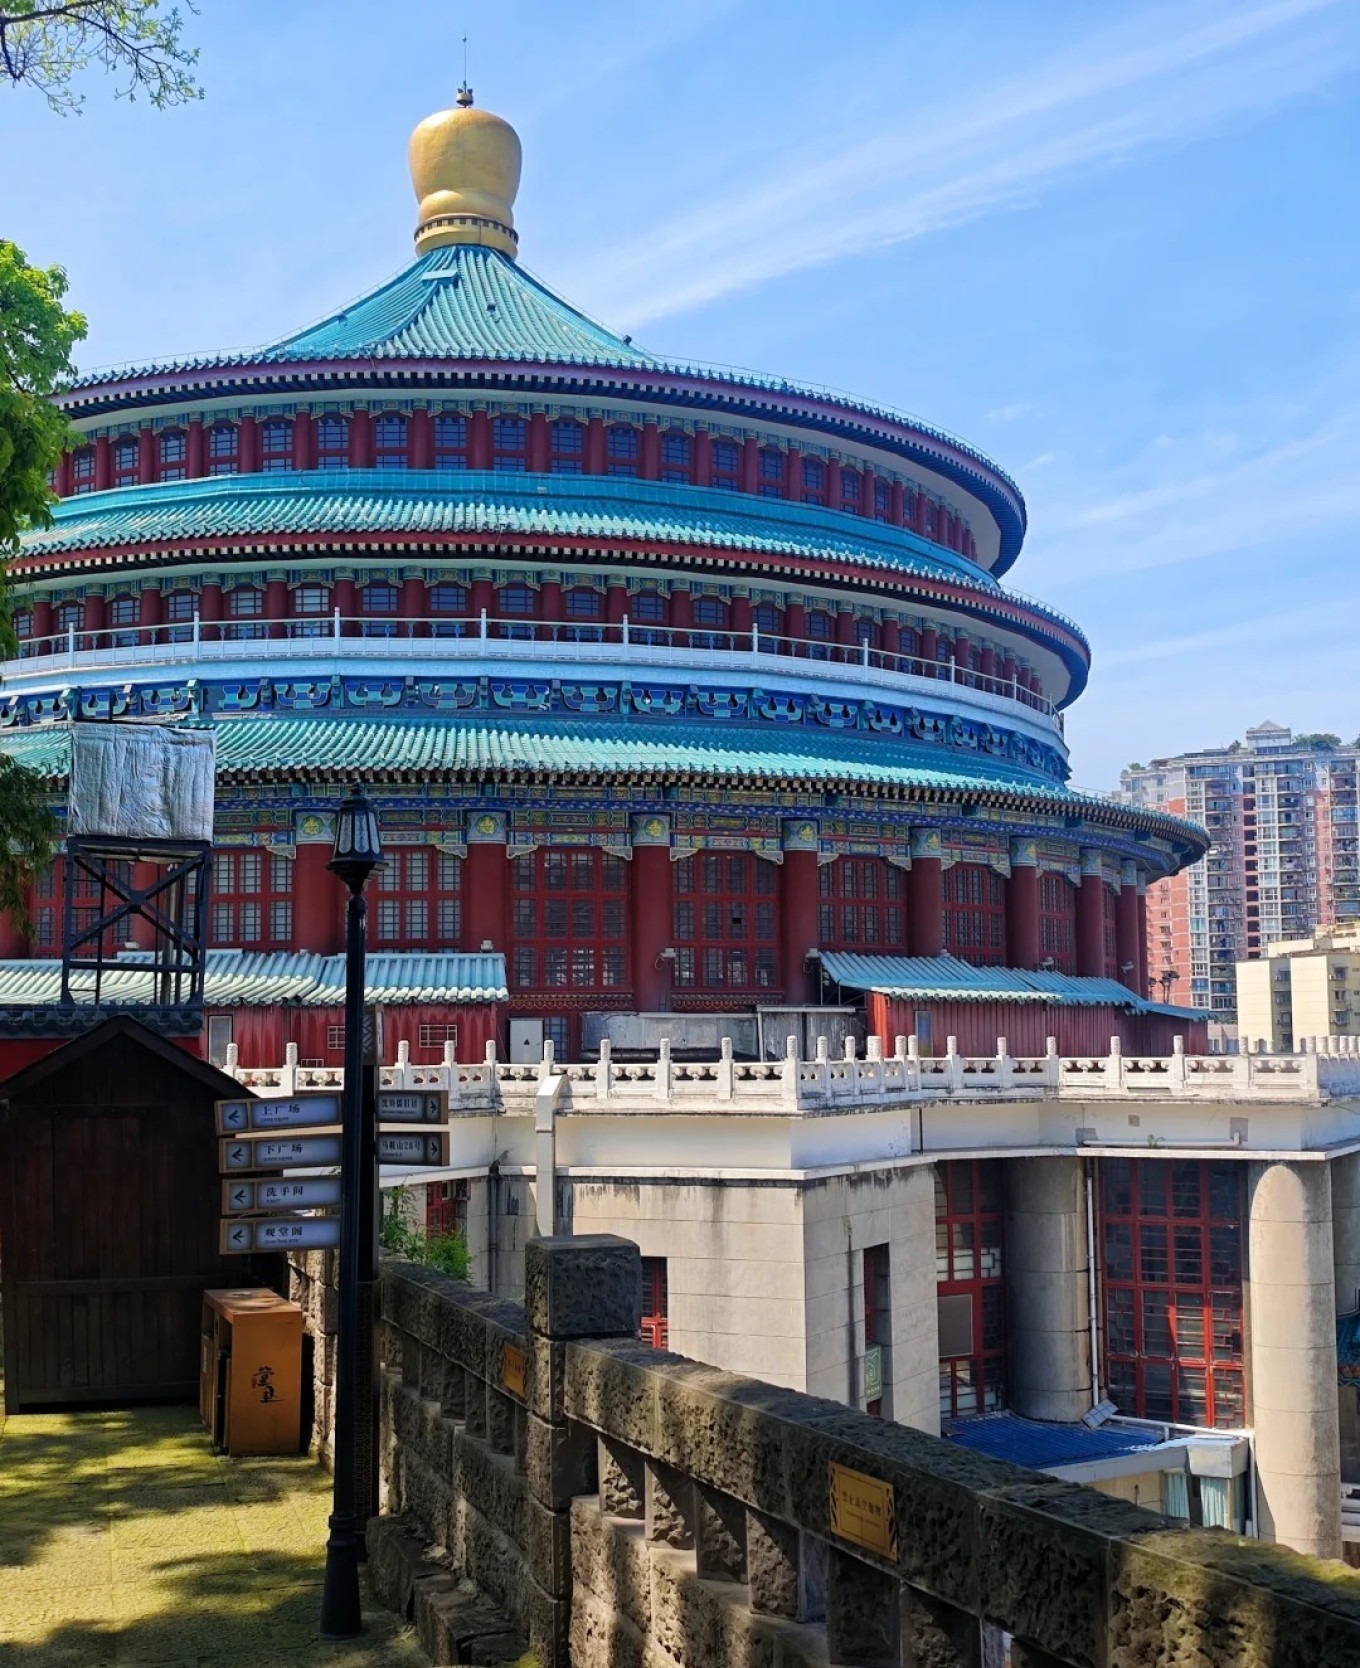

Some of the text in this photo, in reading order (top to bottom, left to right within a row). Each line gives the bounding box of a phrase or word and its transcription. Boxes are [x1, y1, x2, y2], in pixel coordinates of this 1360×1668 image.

[262, 1103, 300, 1115] 上广场
[263, 1144, 304, 1154] 下广场
[265, 1185, 304, 1197] 洗手间
